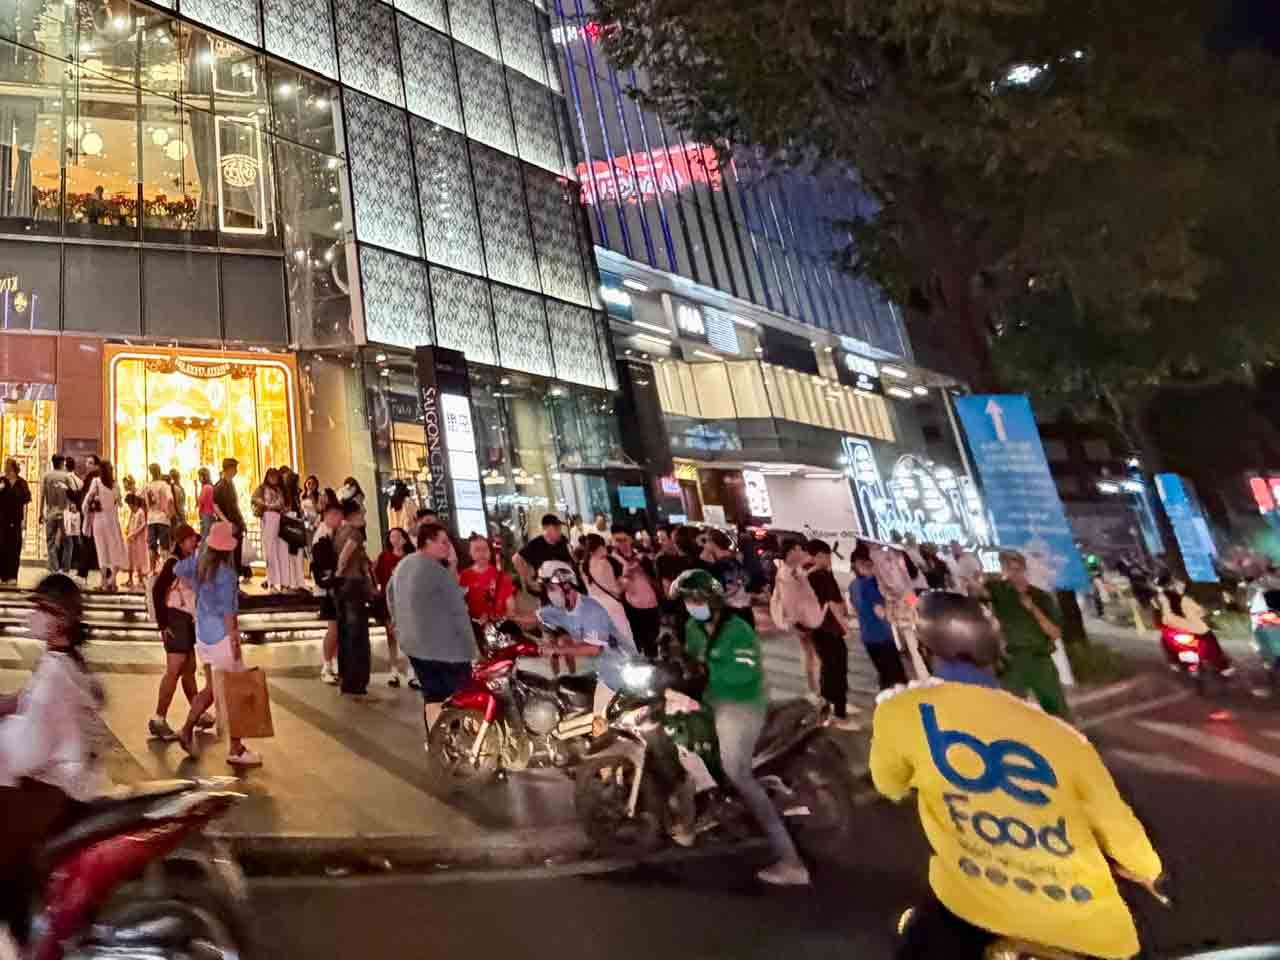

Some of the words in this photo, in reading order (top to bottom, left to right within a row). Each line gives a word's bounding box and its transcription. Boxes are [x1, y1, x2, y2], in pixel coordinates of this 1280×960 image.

[423, 387, 441, 451] SAIGON
[917, 702, 1060, 807] be
[942, 792, 1076, 858] Food
